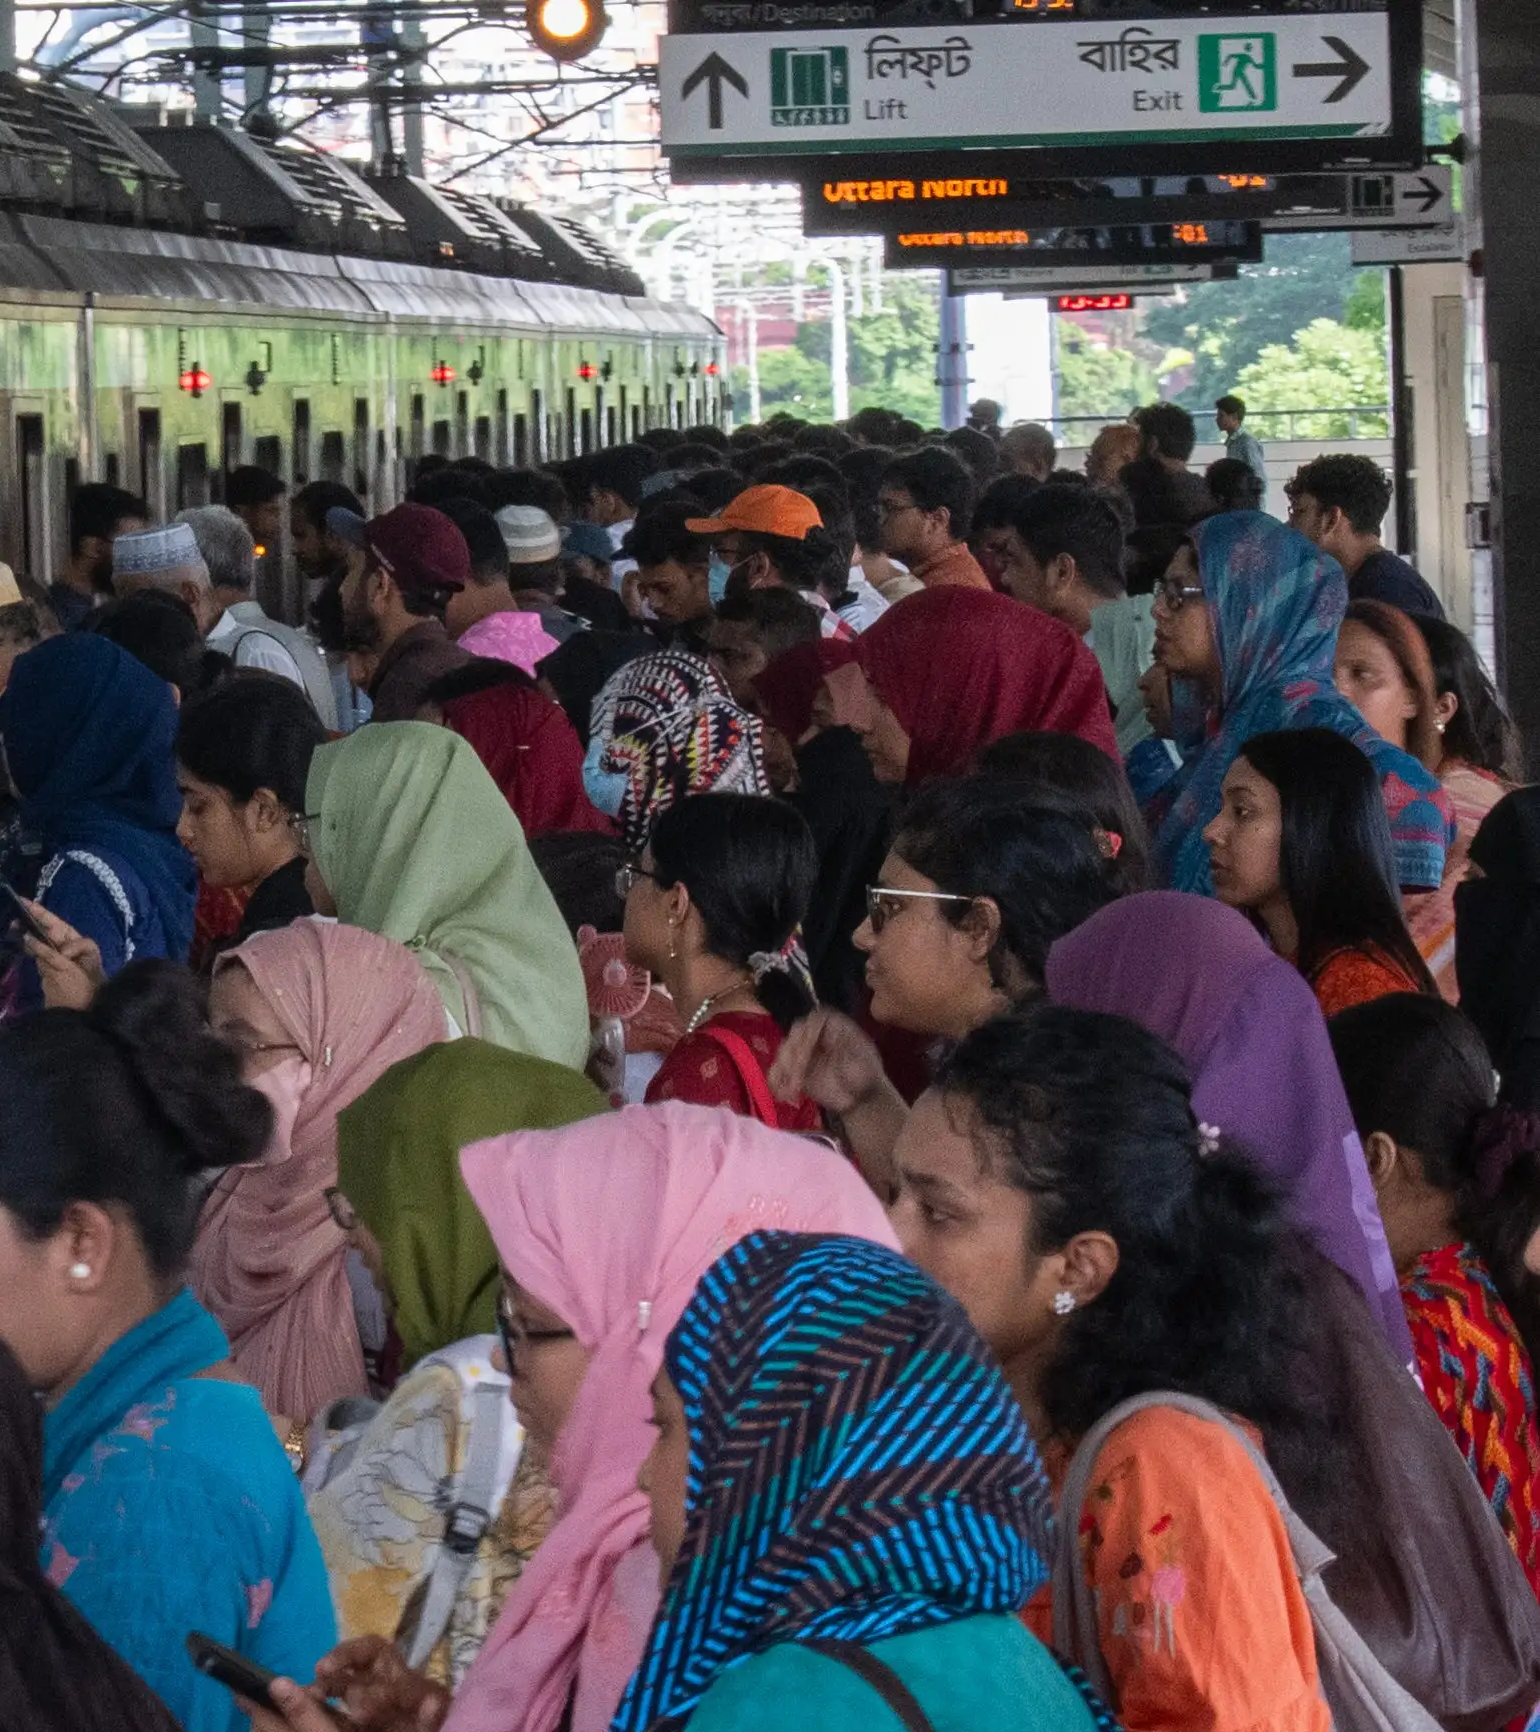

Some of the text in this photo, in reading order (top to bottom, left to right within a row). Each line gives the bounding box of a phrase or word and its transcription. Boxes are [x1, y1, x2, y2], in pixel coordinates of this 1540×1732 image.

[864, 34, 973, 89] লিফ্ট
[1076, 26, 1181, 73] বাহির
[864, 99, 908, 121] Lift
[1132, 89, 1183, 112] Exit
